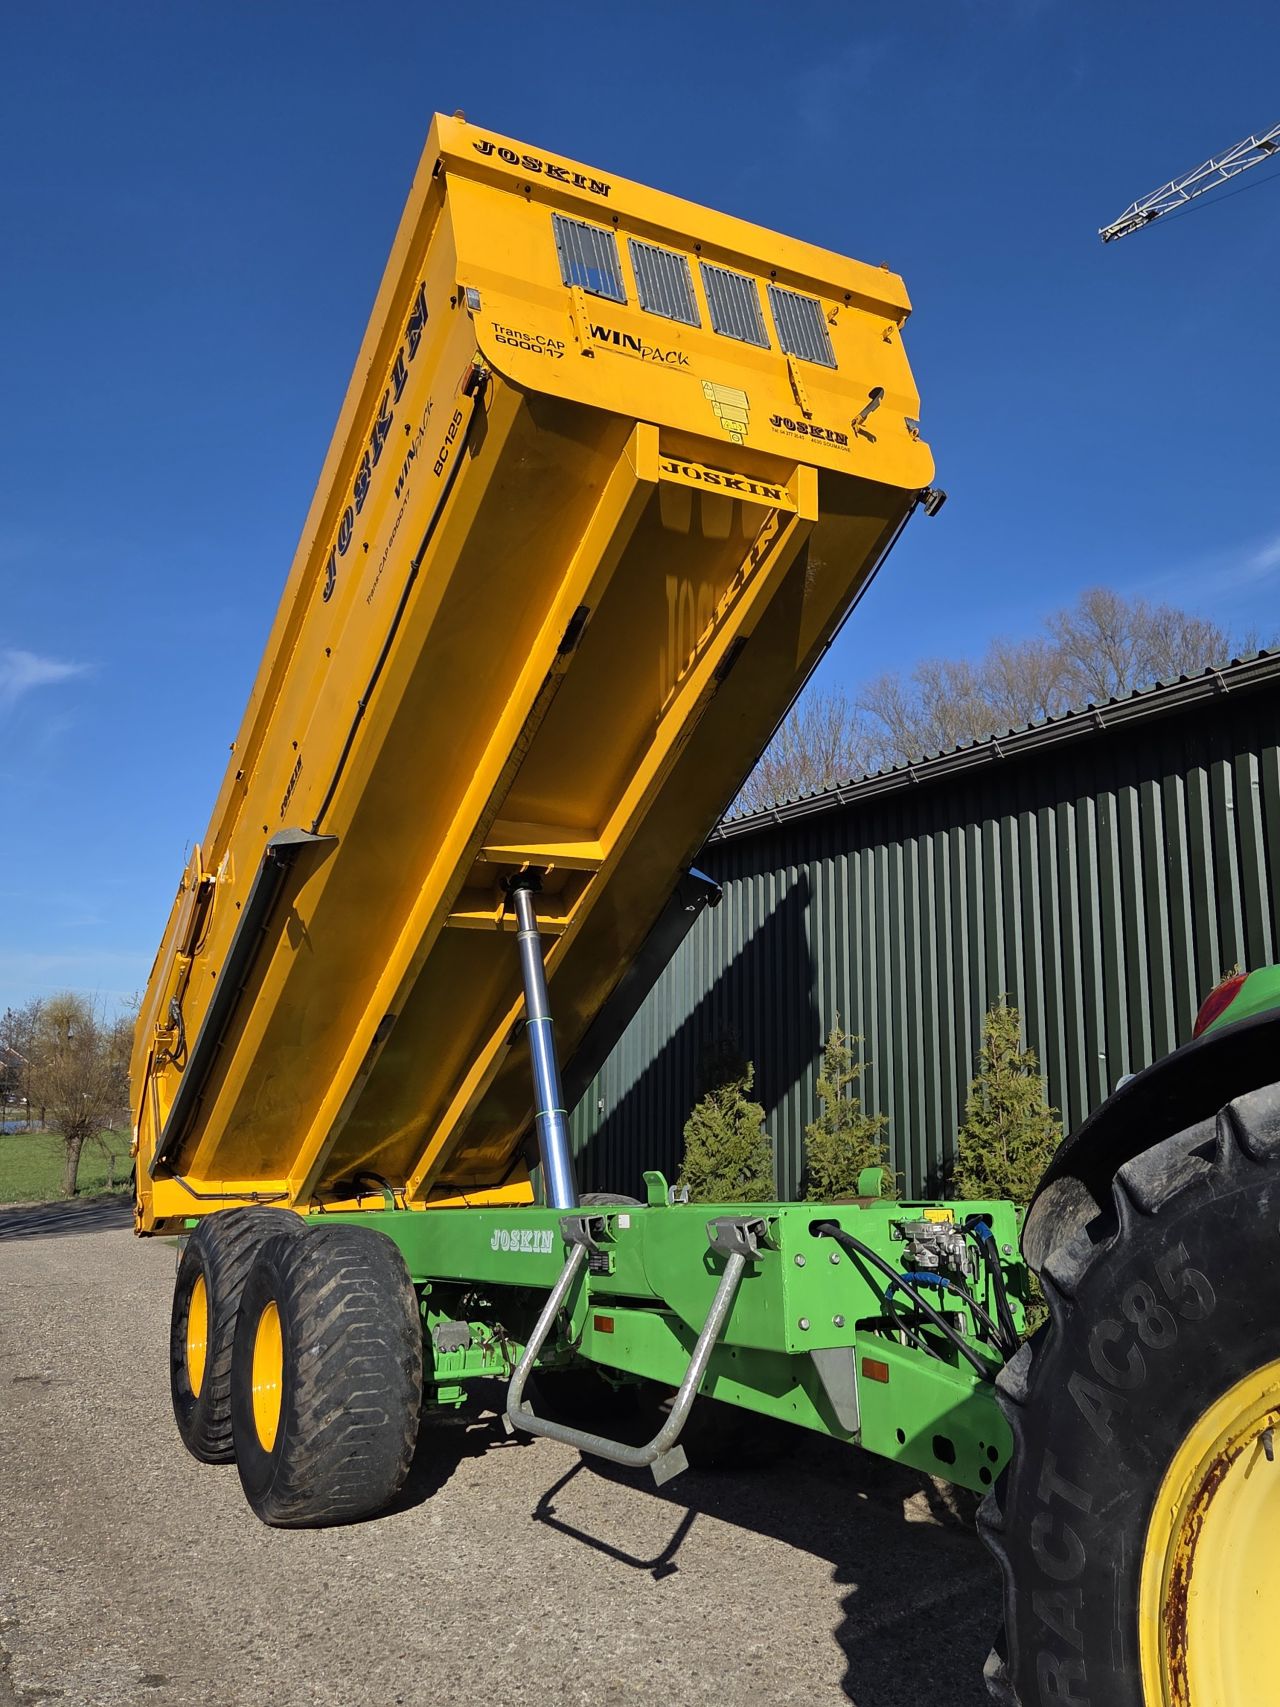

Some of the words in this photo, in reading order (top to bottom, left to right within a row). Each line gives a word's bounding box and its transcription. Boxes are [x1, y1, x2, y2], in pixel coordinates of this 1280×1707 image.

[472, 139, 612, 197] JOSKIN
[491, 322, 565, 350] Trans-CAP
[322, 281, 430, 604] JOSKIN
[433, 410, 464, 478] BC125
[769, 414, 848, 446] JOSKIN
[662, 462, 789, 501] JOSKIN
[490, 1229, 554, 1254] JOSKIN
[1067, 1242, 1217, 1446] AC85
